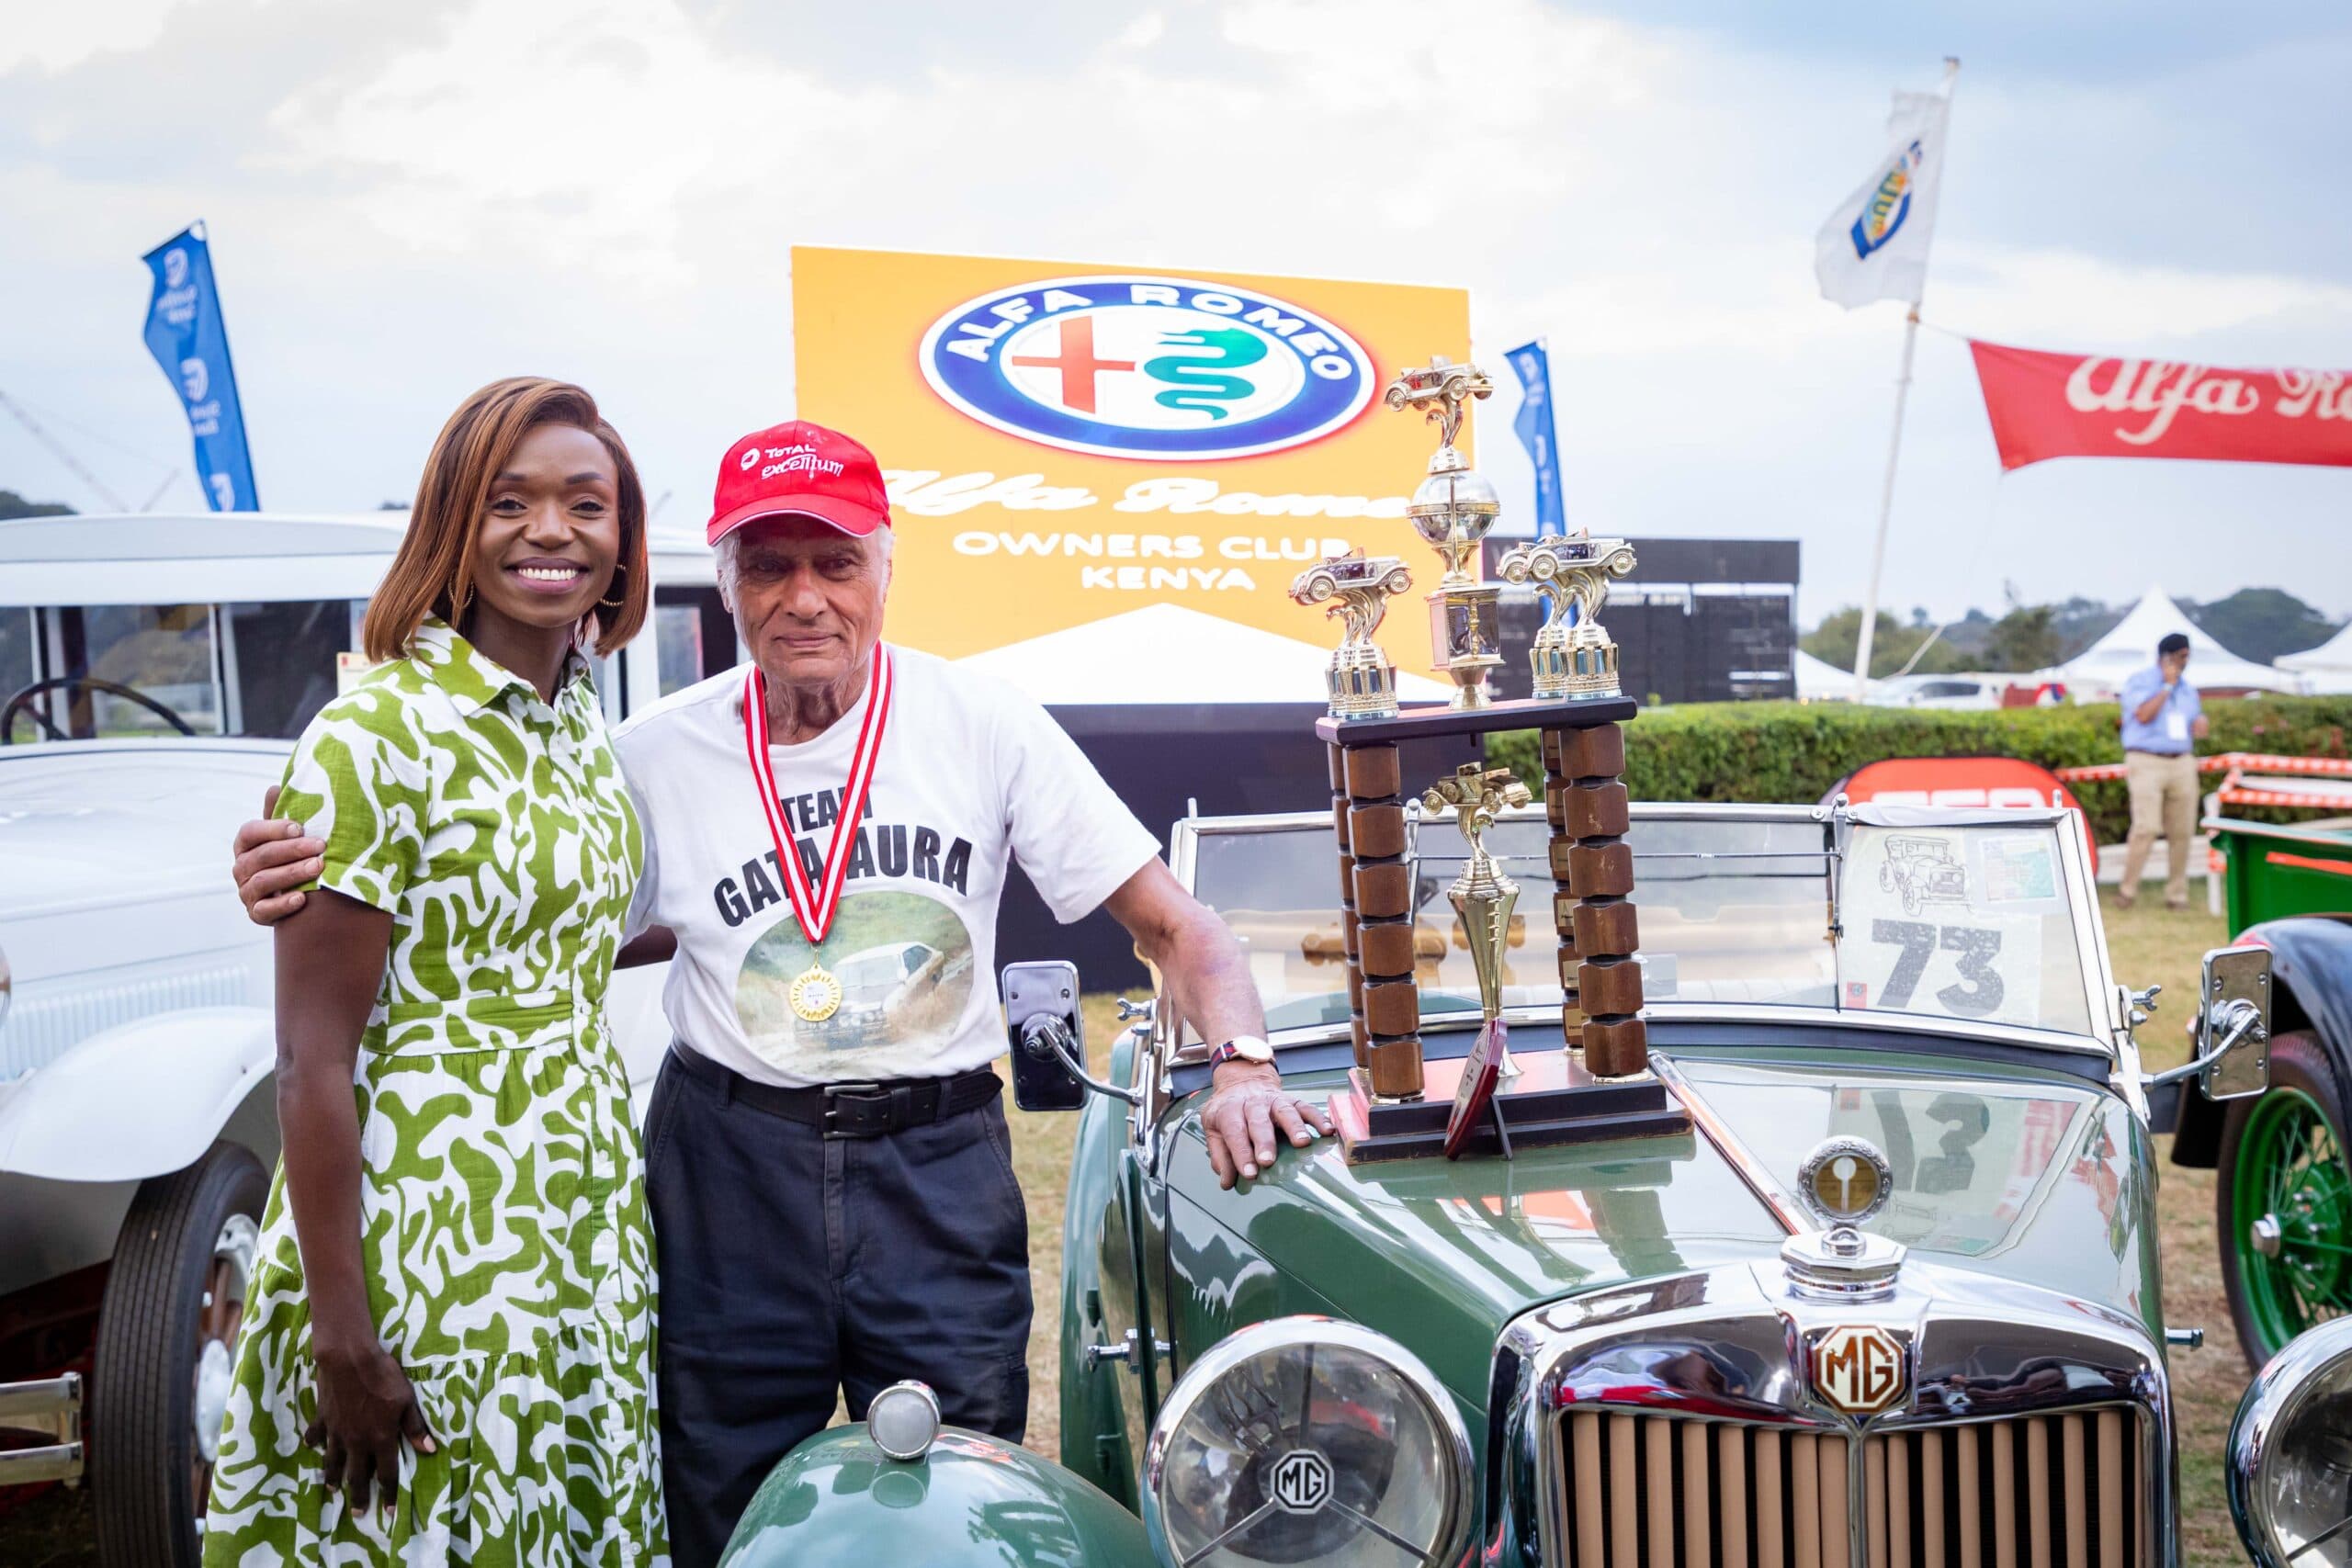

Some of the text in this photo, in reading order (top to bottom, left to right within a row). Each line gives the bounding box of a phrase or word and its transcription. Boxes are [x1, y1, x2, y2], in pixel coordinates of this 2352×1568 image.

[946, 284, 1353, 380] ALFA ROMEO
[2065, 355, 2259, 446] Alfa
[764, 444, 816, 458] TOTAL
[1114, 477, 1411, 518] Rome
[952, 531, 1202, 559] OWNERS
[1080, 566, 1256, 591] KENYA
[713, 824, 973, 928] GATAAURA
[1871, 919, 2005, 1018] 73
[1826, 1335, 1894, 1404] MG
[1283, 1461, 1322, 1501] MG
